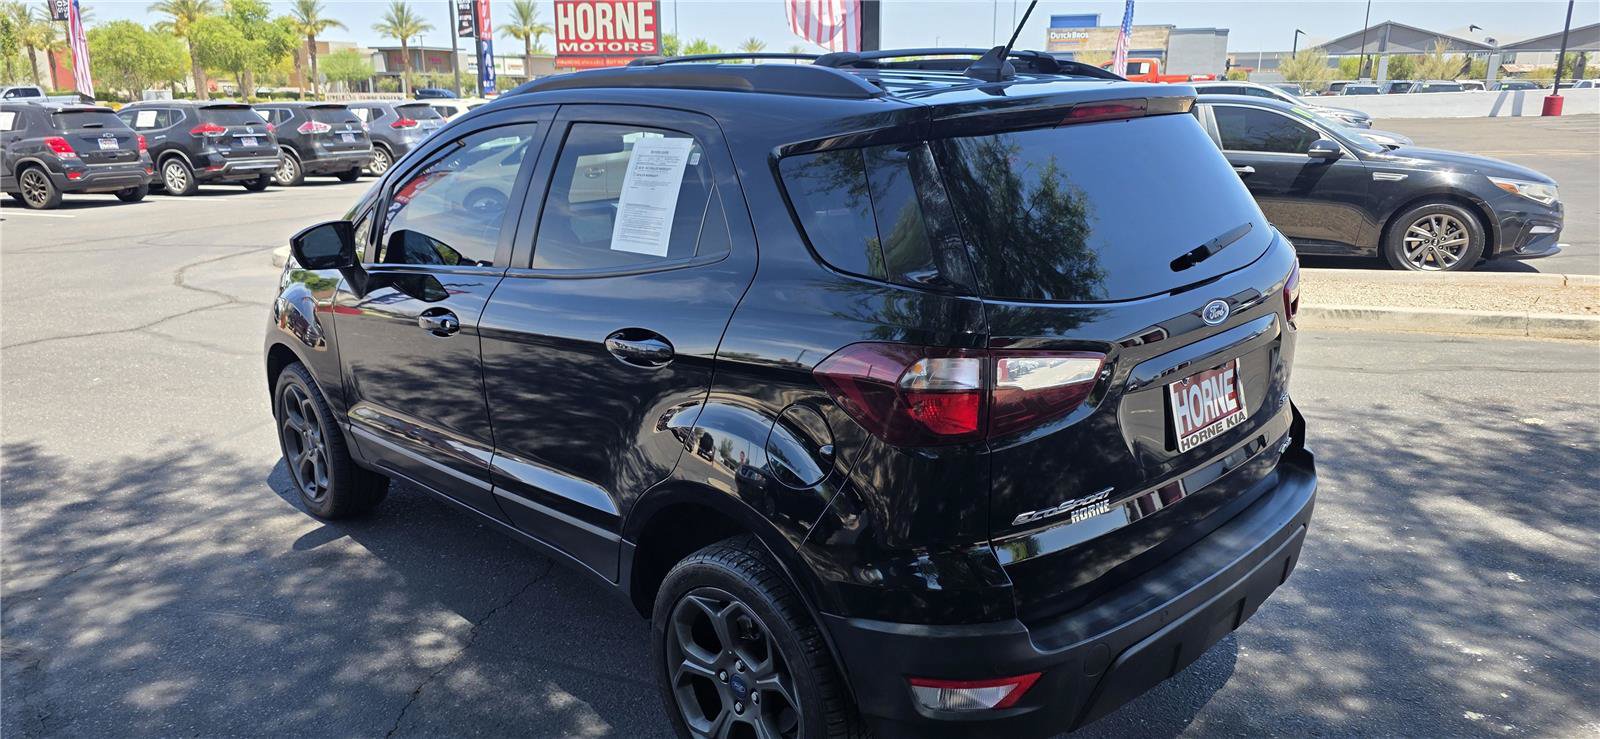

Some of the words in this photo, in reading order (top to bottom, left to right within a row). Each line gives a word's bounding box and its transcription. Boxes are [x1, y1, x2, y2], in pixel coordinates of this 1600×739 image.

[557, 2, 655, 40] HORNE
[559, 42, 655, 53] MOTORS
[1207, 303, 1226, 321] Ford
[1174, 368, 1237, 434] HORNE
[1180, 423, 1223, 452] HORNE
[1226, 412, 1247, 428] KIA
[1071, 498, 1110, 525] HORNE
